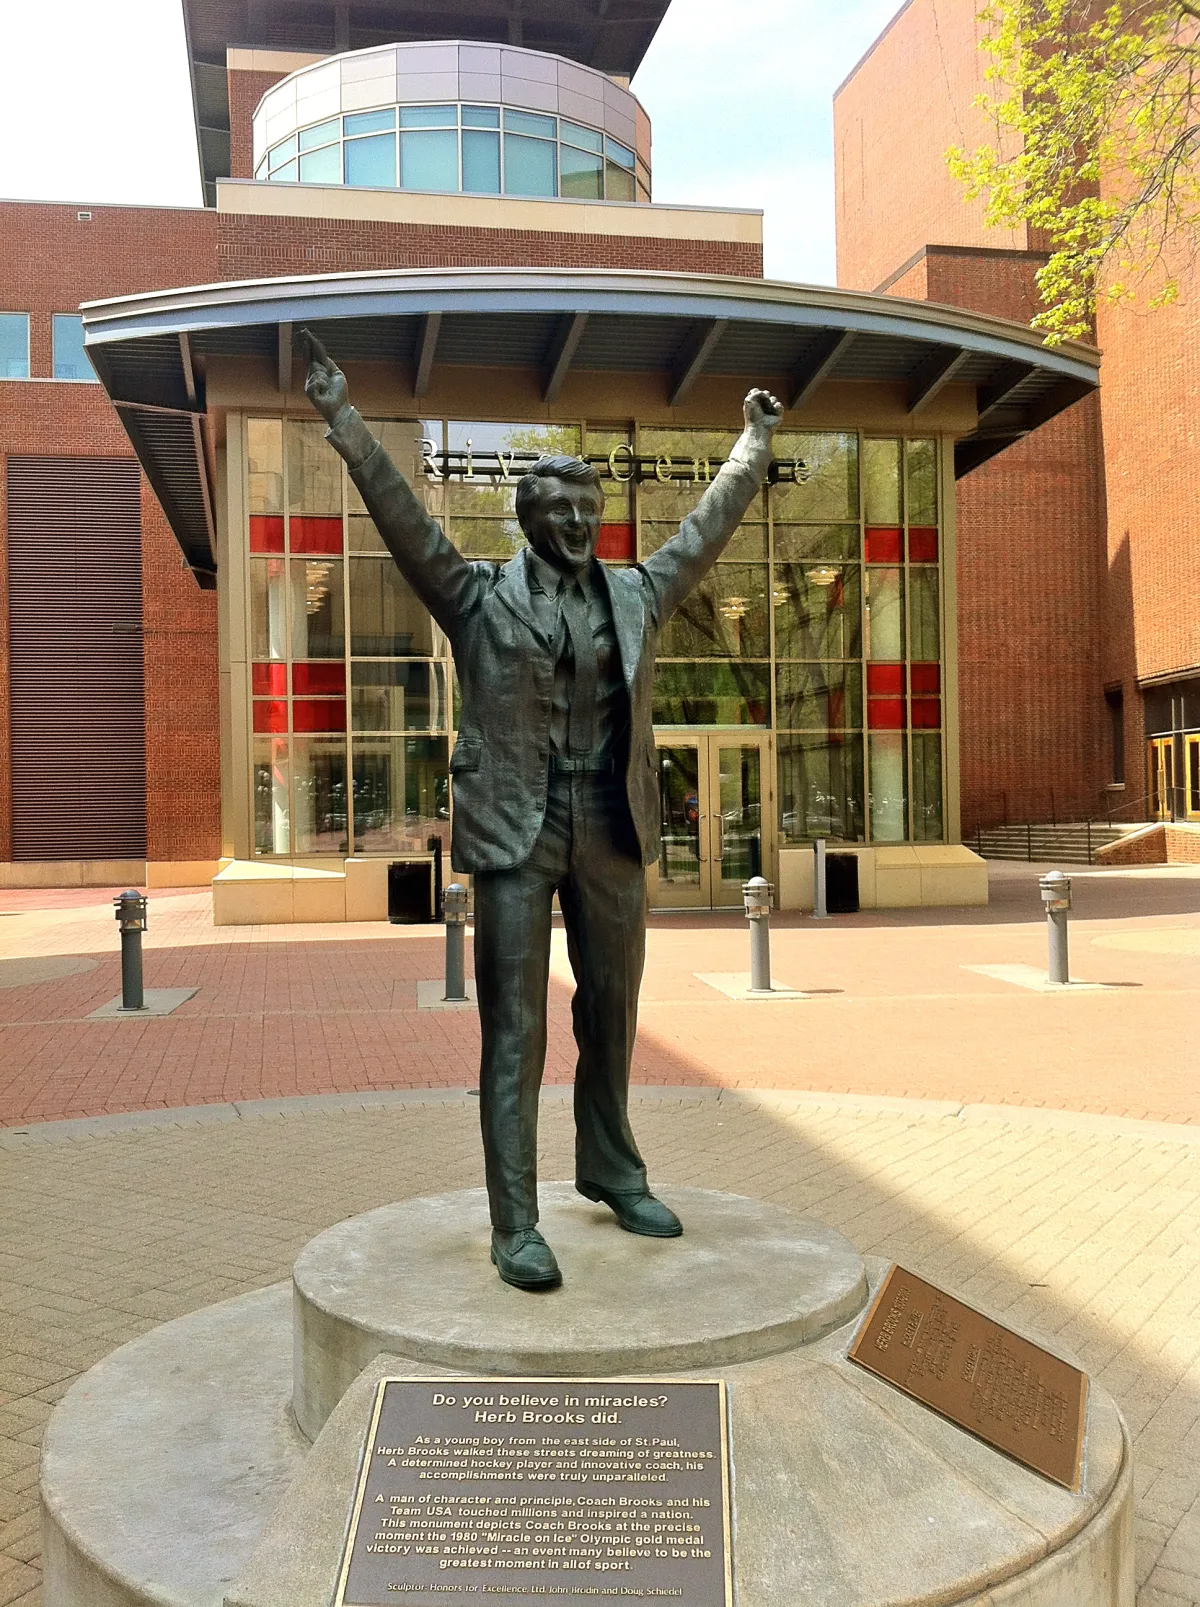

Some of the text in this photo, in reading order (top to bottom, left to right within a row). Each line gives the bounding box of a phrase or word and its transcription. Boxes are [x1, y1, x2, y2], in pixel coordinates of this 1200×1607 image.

[433, 1394, 668, 1408] Do you believe in miracles?
[475, 1411, 622, 1424] Herb Brooks did.
[414, 1436, 430, 1444] As
[444, 1438, 480, 1446] young
[483, 1436, 504, 1446] boy
[509, 1436, 536, 1444] from
[542, 1437, 560, 1445] the
[592, 1438, 616, 1446] side
[620, 1438, 632, 1446] of
[377, 1446, 716, 1460] Herb Brooks walked these streets dreaming of greatness.
[388, 1458, 704, 1470] A determined hockey player and innovative coach, his
[419, 1470, 523, 1481] accomplishments
[560, 1472, 588, 1482] truly
[592, 1472, 668, 1482] unparalleled.
[375, 1494, 384, 1502] A
[418, 1494, 431, 1503] of
[434, 1495, 492, 1504] character
[494, 1496, 516, 1504] and
[520, 1496, 576, 1507] principle,
[577, 1496, 616, 1506] Coach
[619, 1497, 662, 1506] Brooks
[666, 1498, 689, 1506] and
[692, 1498, 710, 1506] his
[390, 1506, 421, 1515] Team
[426, 1506, 452, 1516] USA
[458, 1507, 508, 1516] touched
[511, 1508, 557, 1517] millions
[561, 1509, 584, 1518] and
[587, 1509, 636, 1520] inspired
[652, 1510, 693, 1519] nation.
[381, 1518, 700, 1533] This monument depicts Coach Brooks at the precise
[375, 1532, 424, 1540] moment
[428, 1532, 446, 1541] the
[450, 1532, 478, 1541] 1980
[580, 1534, 631, 1545] Olympic
[635, 1535, 662, 1546] gold
[666, 1535, 704, 1544] medal
[366, 1543, 410, 1555] victory
[415, 1546, 439, 1554] was
[443, 1544, 498, 1554] achieved
[532, 1547, 566, 1556] event
[569, 1548, 602, 1558] many
[607, 1547, 651, 1557] believe
[655, 1548, 668, 1557] to
[672, 1548, 687, 1558] be
[691, 1548, 711, 1558] the
[440, 1558, 492, 1569] greatest
[494, 1560, 545, 1568] moment
[548, 1559, 558, 1568] in
[578, 1560, 591, 1569] of
[430, 1583, 462, 1591] Honors
[466, 1584, 478, 1592] for
[620, 1587, 644, 1596] Doug
